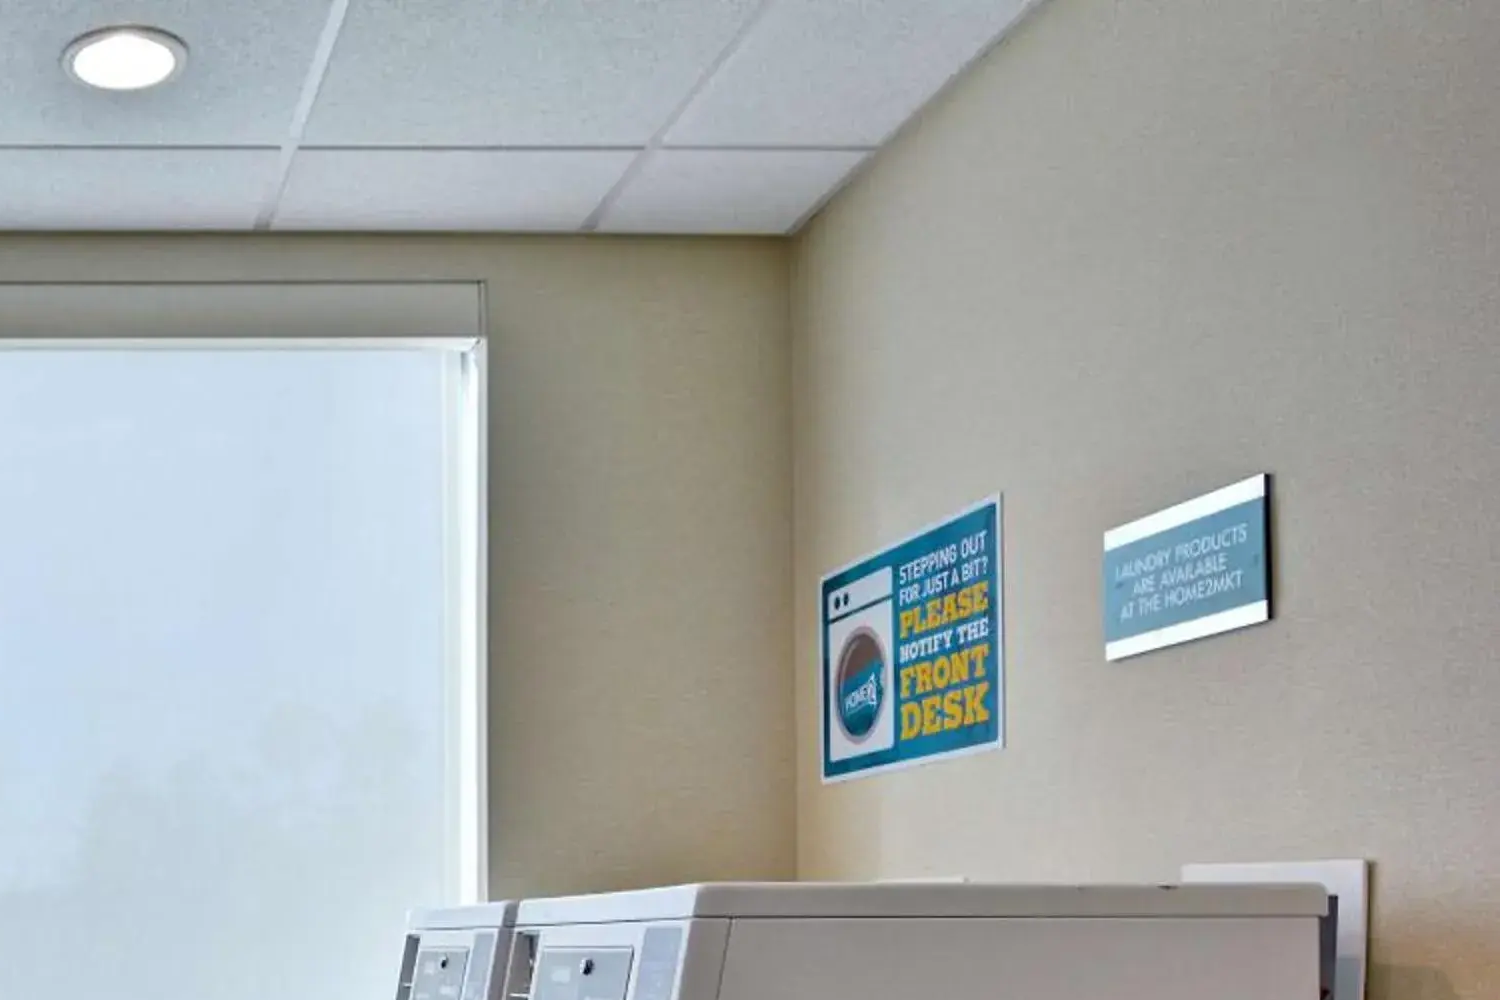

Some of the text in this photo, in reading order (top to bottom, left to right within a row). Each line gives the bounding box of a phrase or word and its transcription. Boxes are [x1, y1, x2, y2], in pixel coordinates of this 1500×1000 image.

[899, 529, 988, 585] STEPPING OUT
[1115, 522, 1247, 580] LAUNDRY PRODUCTS
[1132, 552, 1228, 598] ARE AVAILABLE
[900, 555, 988, 607] FOR JUST A BIT?
[1120, 600, 1134, 624] AT
[1138, 593, 1160, 617] THE
[900, 580, 988, 639] PLEASE
[899, 615, 988, 662] NOTIFY THE
[900, 643, 988, 698] FRONT
[900, 681, 989, 740] DESK
